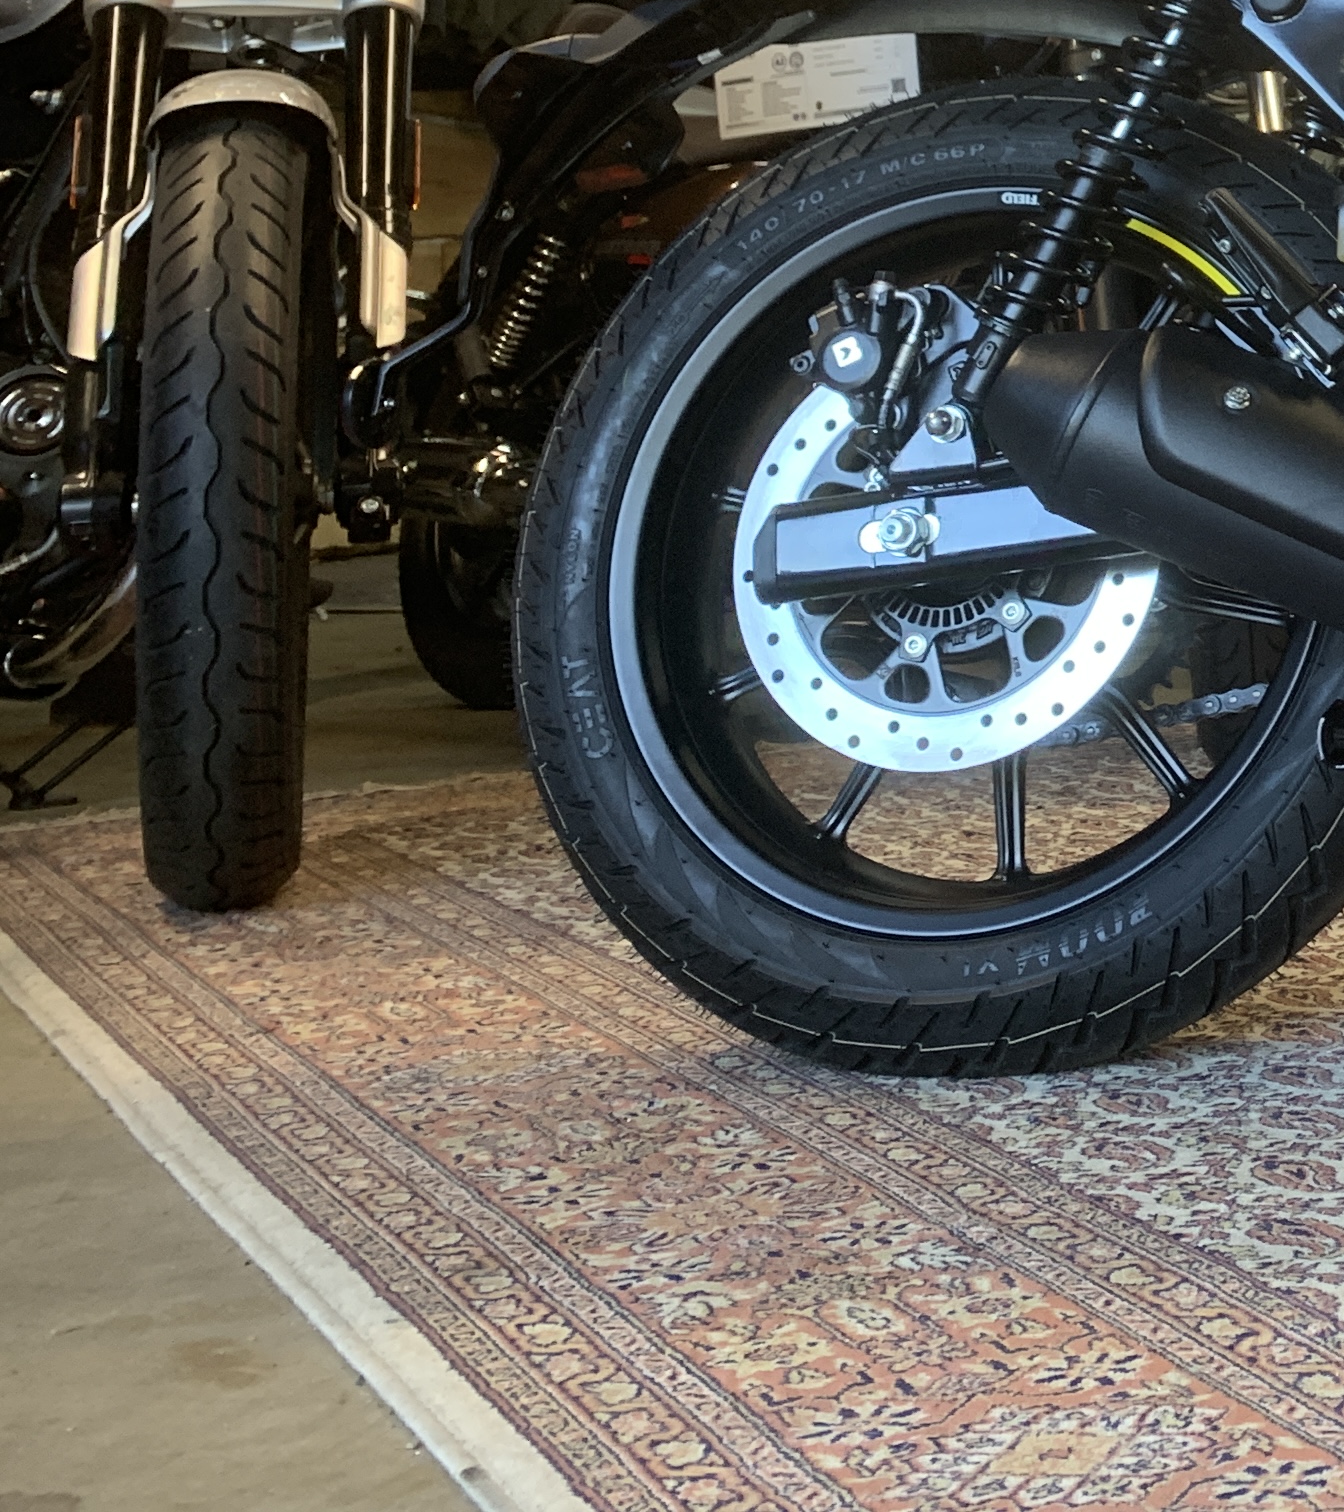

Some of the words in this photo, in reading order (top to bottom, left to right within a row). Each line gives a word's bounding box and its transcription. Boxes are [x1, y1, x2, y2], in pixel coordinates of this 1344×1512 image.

[1000, 191, 1040, 206] FIELD
[563, 528, 582, 585] NYLON
[560, 655, 614, 759] CEAT
